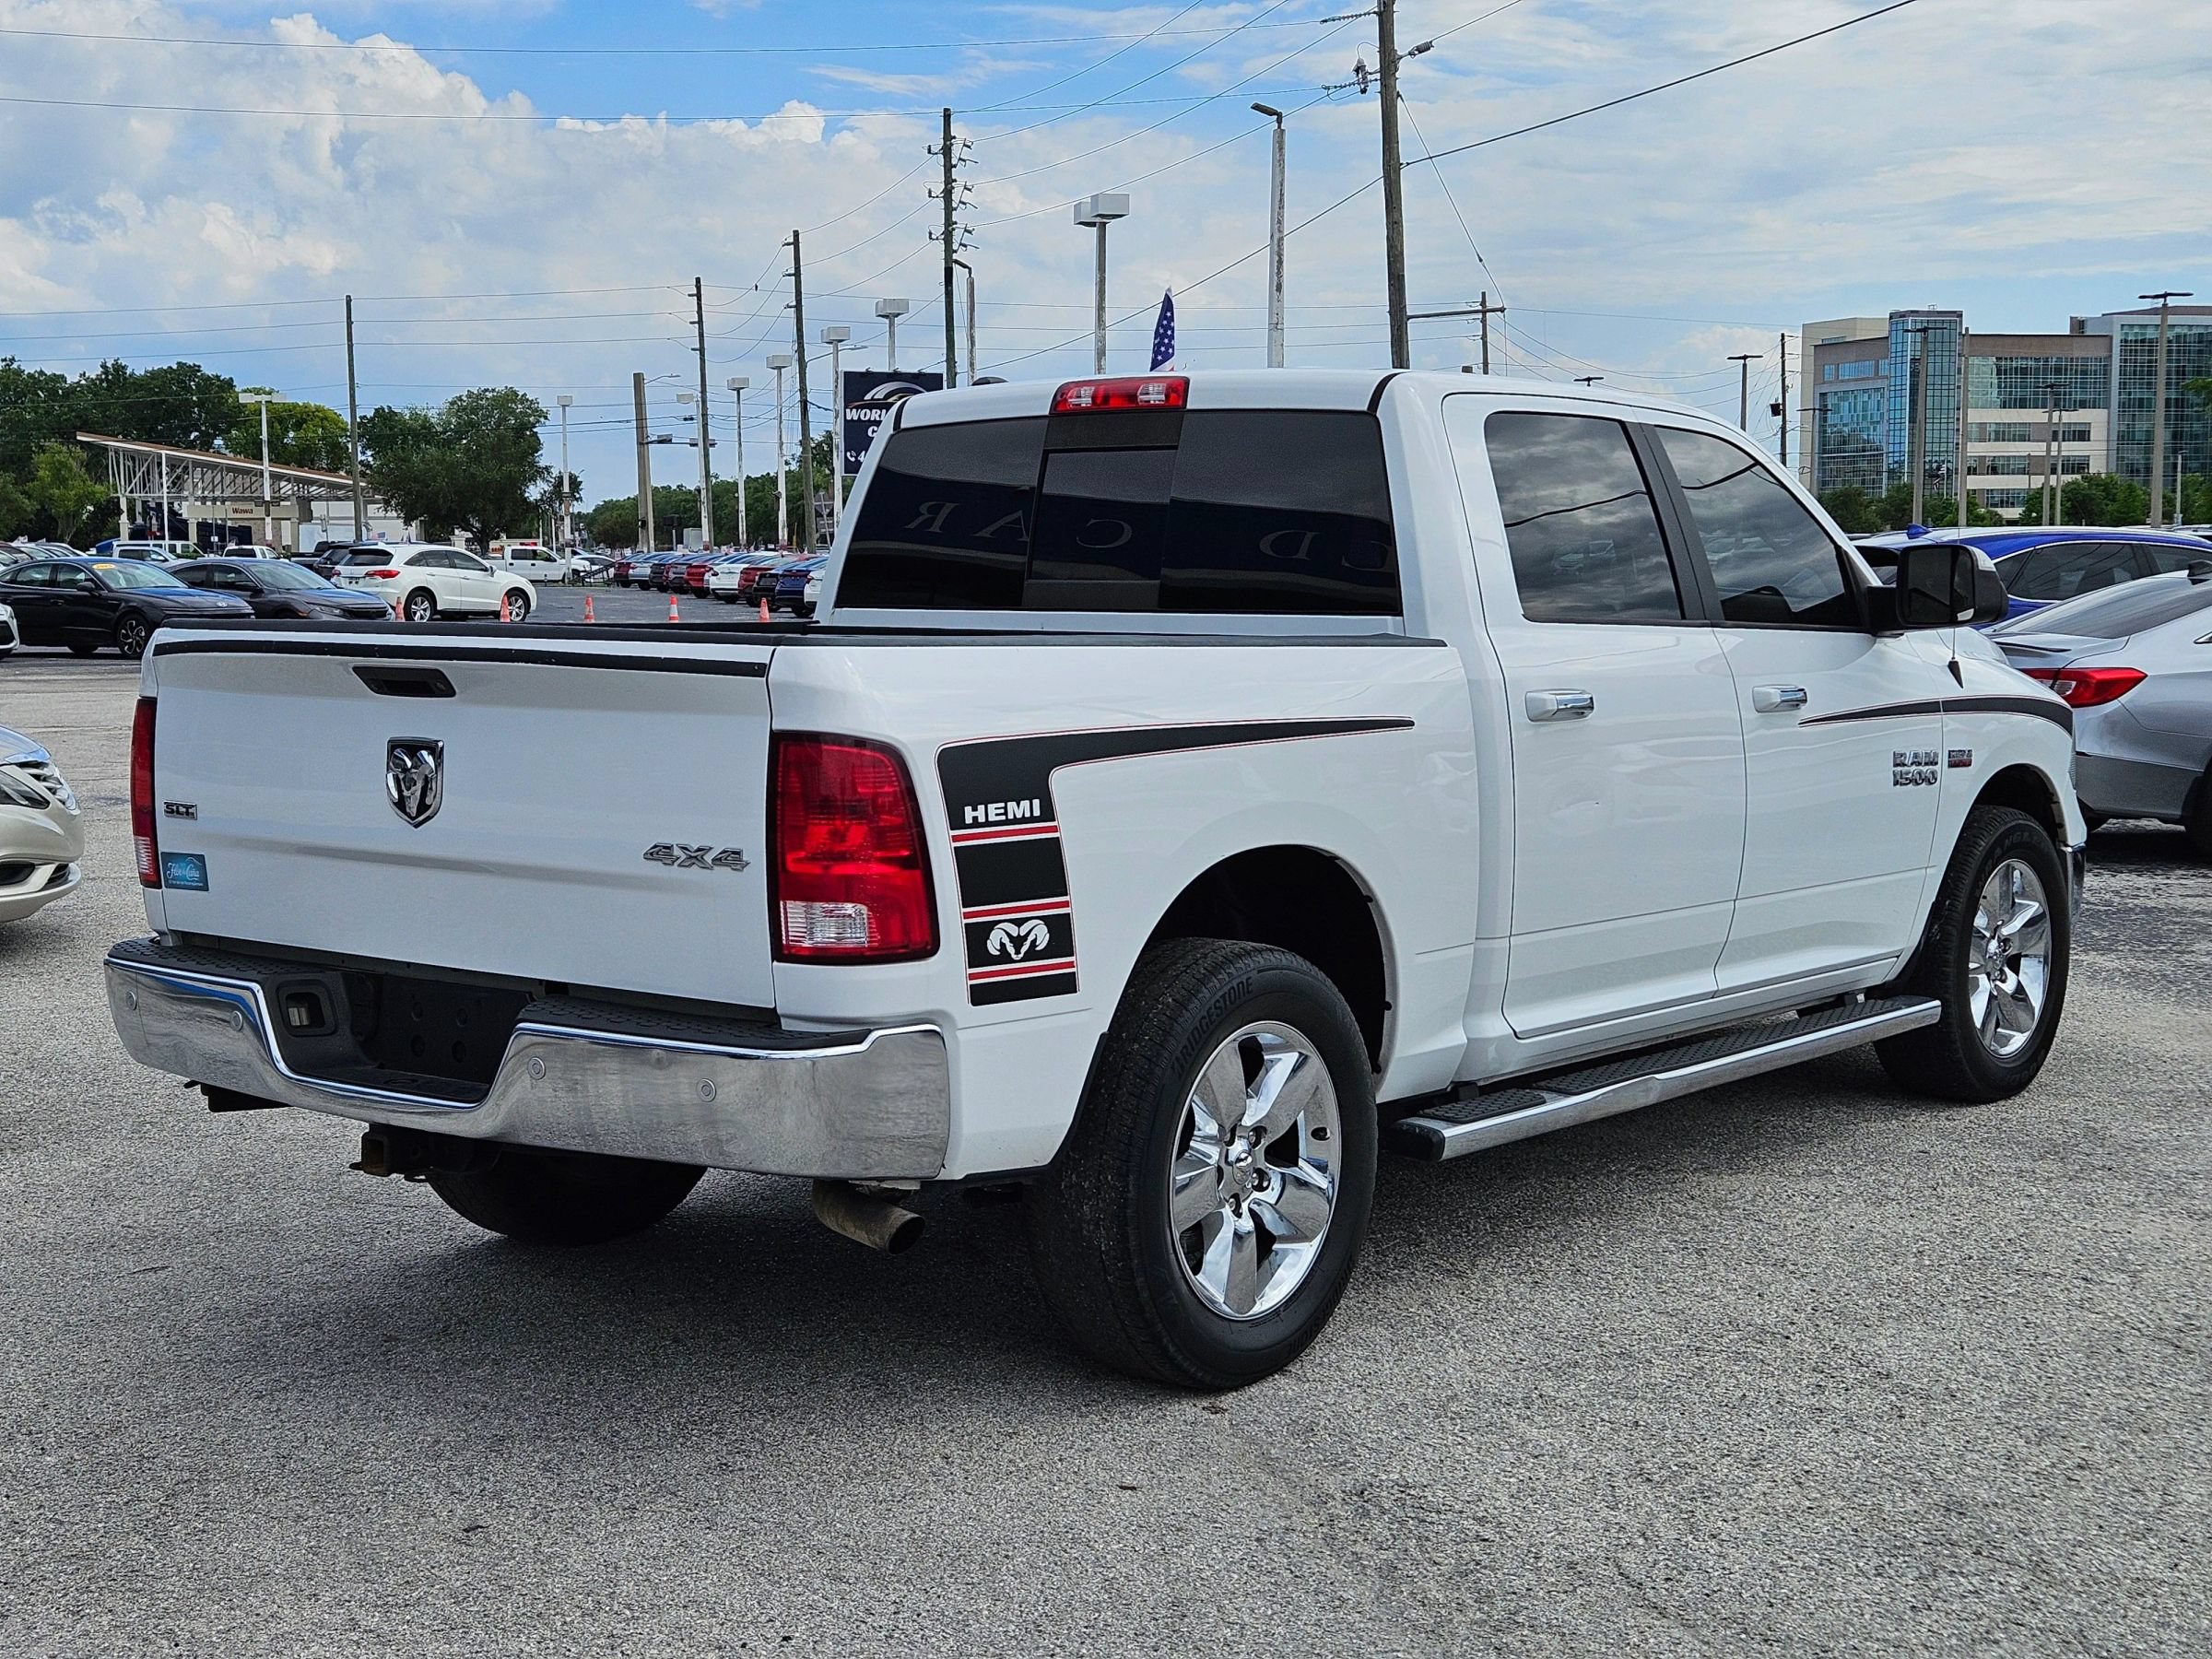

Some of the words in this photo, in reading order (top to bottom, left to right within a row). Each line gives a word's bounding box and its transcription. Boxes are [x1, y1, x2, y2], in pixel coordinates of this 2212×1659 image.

[1892, 750, 1939, 768] RAM
[1892, 768, 1938, 787] 1500
[164, 800, 198, 820] SLT
[964, 798, 1041, 824] HEMI
[1171, 975, 1254, 1081] BRIDGESTONE
